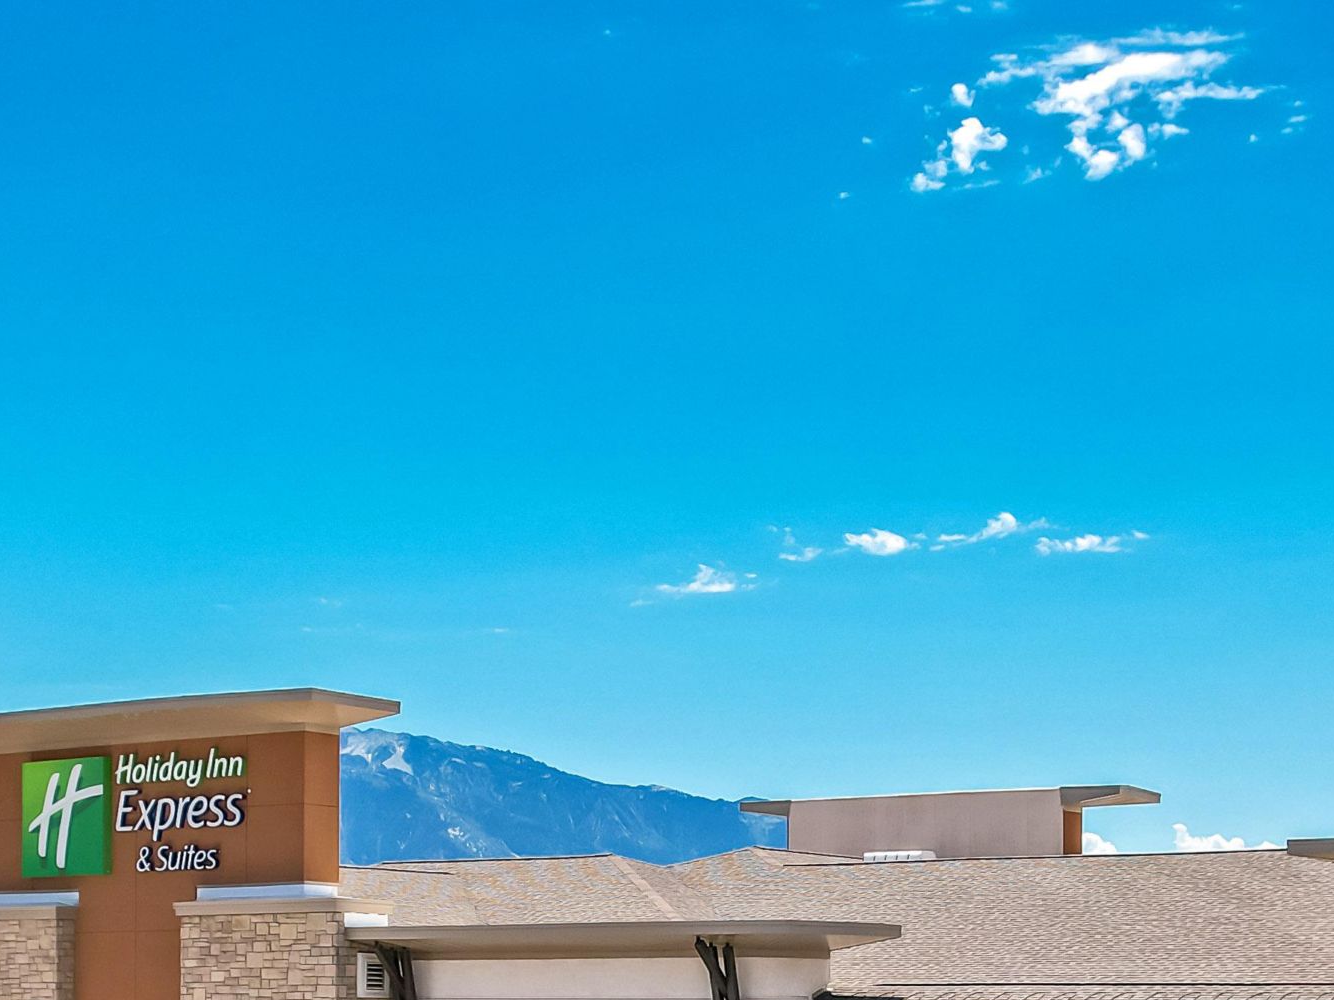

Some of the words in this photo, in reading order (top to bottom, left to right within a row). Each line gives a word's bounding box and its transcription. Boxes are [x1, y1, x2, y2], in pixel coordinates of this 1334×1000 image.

[115, 752, 203, 787] Holiday
[206, 748, 243, 778] Inn
[115, 789, 243, 841] Express
[136, 846, 151, 872] &
[155, 844, 218, 871] Suites
